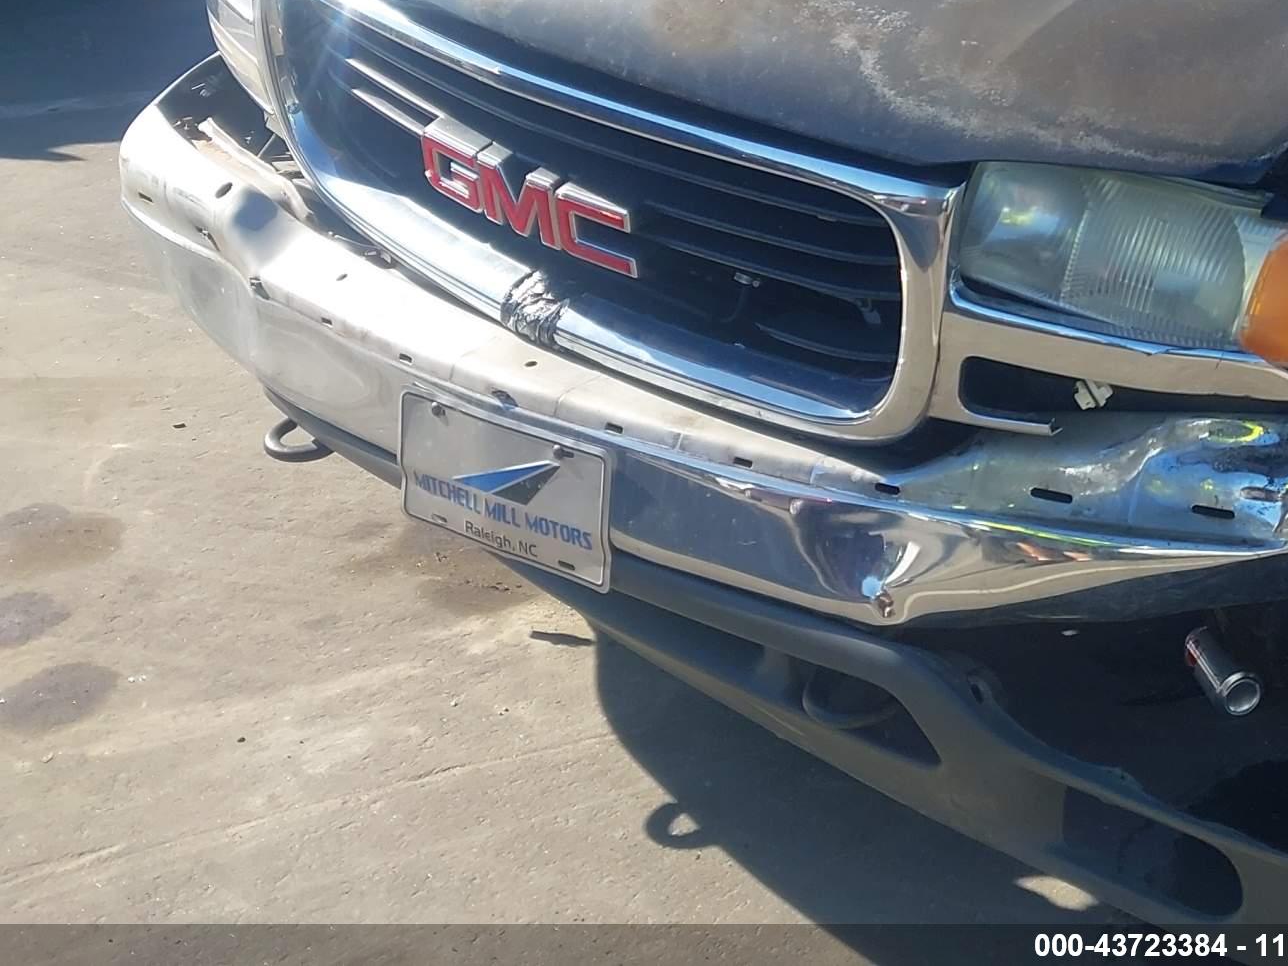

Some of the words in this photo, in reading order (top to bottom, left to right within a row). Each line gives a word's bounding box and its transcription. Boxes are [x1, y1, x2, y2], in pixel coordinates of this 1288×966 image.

[421, 122, 638, 279] GMC
[413, 471, 481, 515] MITCHELL
[484, 498, 521, 528] MILL
[524, 512, 593, 551] MOTORS
[464, 520, 516, 552] Raleigh,
[518, 541, 538, 558] NC
